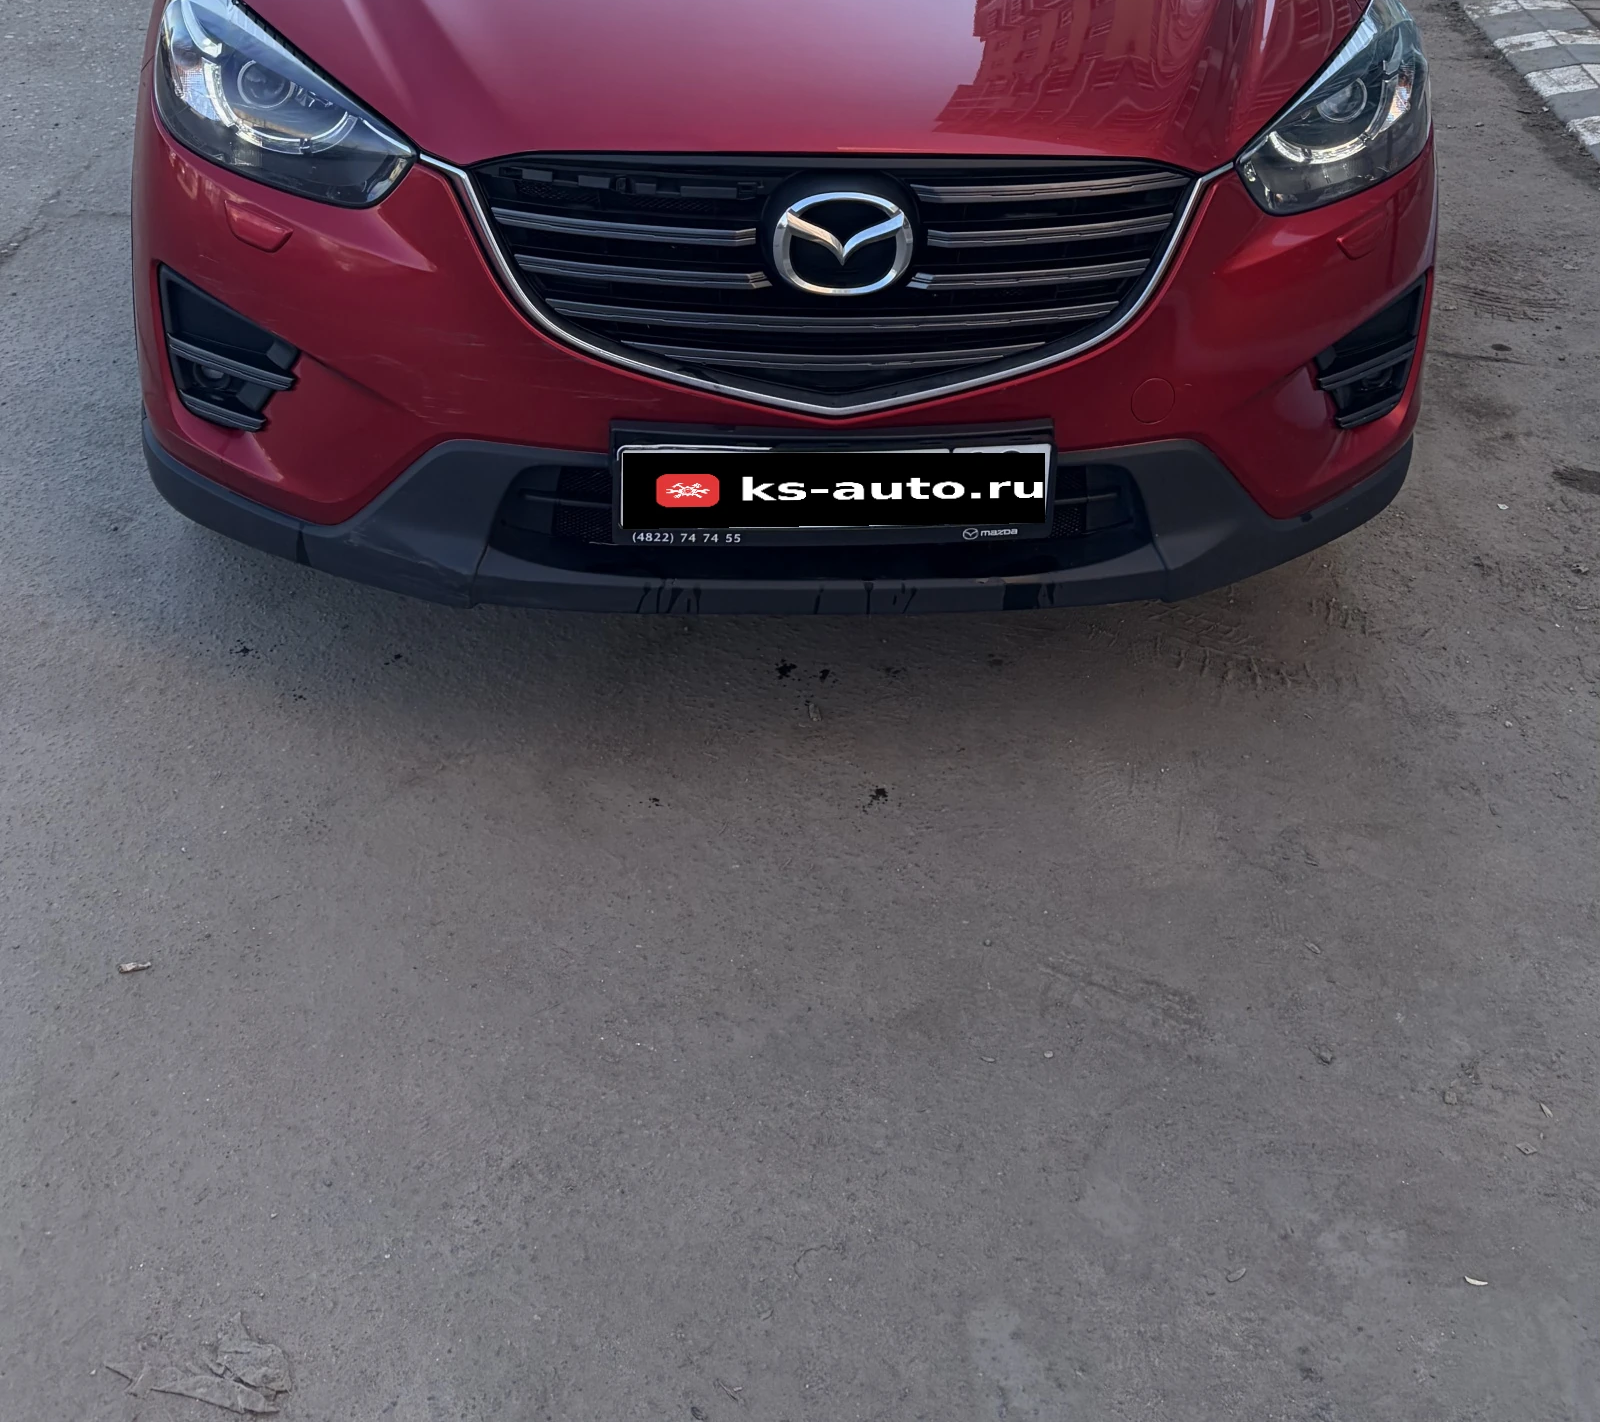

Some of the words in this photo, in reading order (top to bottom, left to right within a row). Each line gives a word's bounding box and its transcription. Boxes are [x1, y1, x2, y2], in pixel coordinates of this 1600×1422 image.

[632, 532, 674, 544] (4822)
[680, 533, 696, 543] 74
[703, 533, 719, 543] 74
[725, 533, 741, 543] 55
